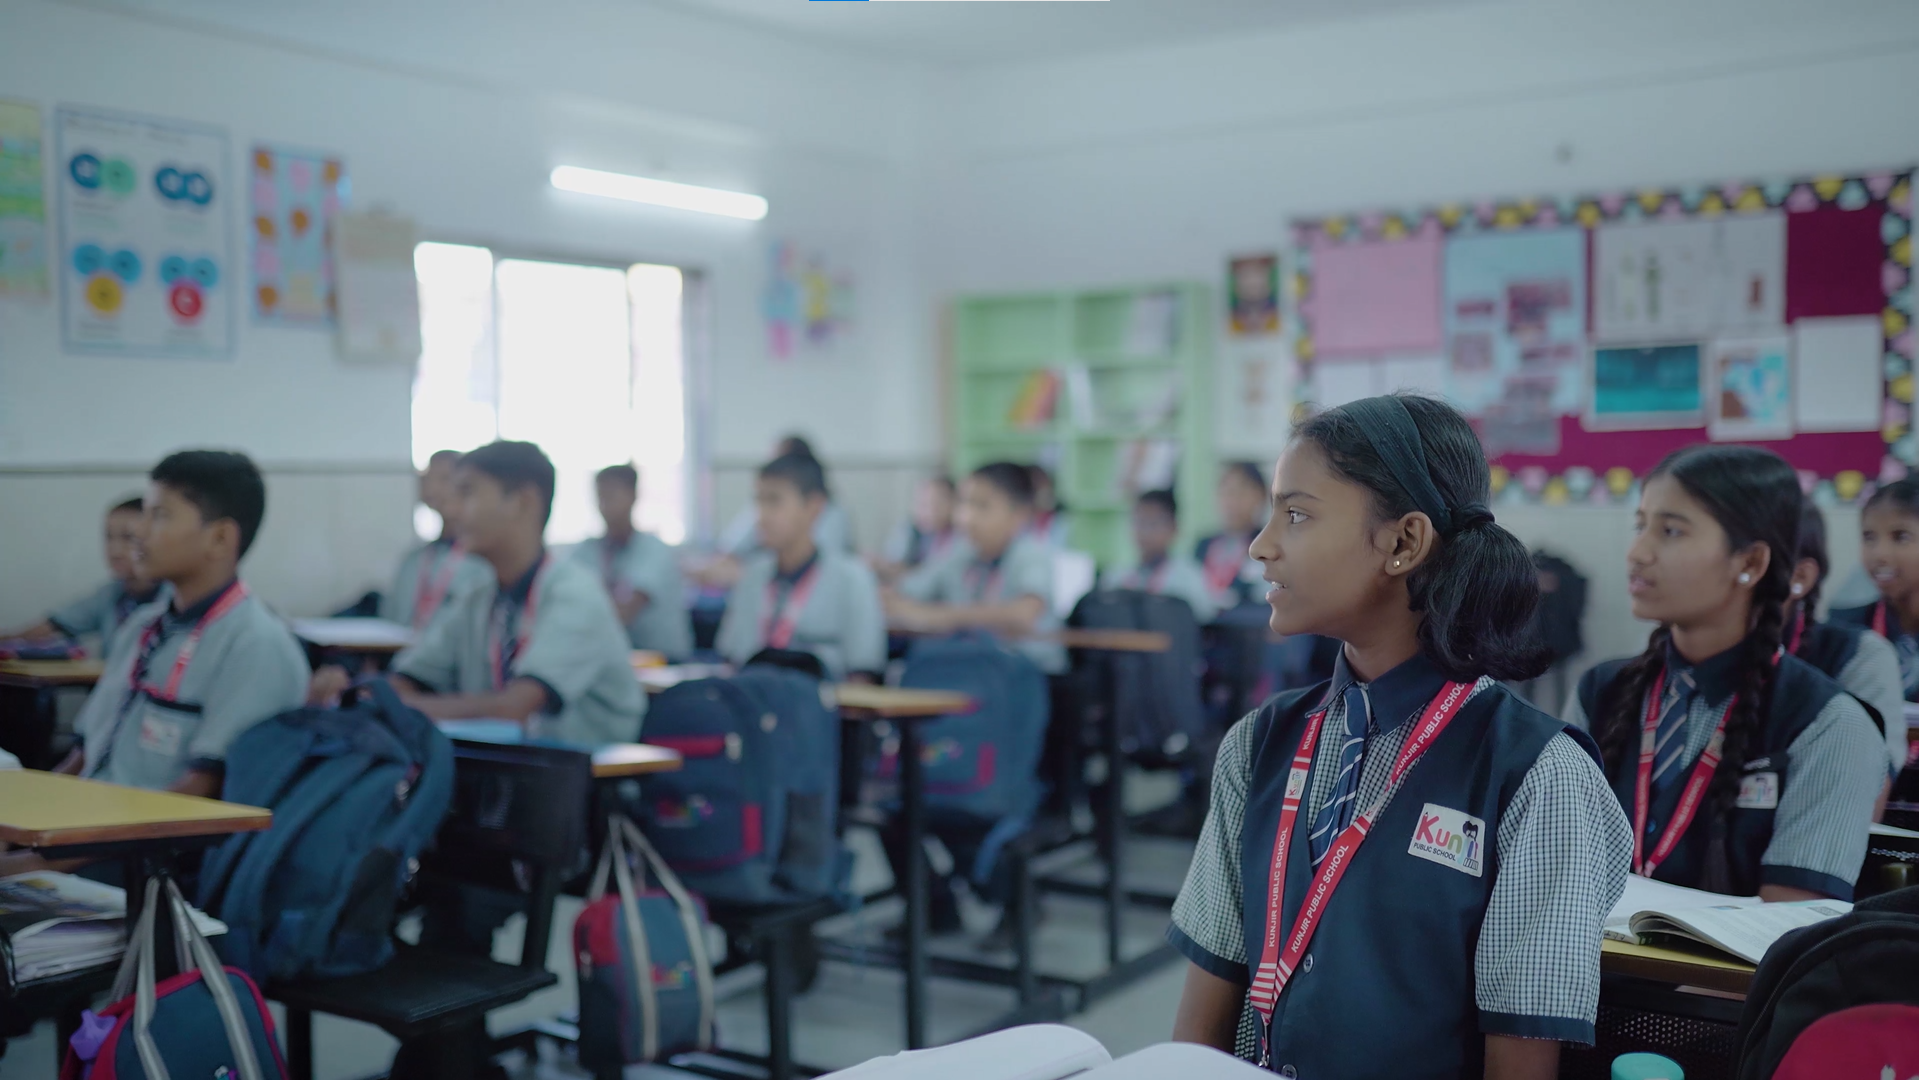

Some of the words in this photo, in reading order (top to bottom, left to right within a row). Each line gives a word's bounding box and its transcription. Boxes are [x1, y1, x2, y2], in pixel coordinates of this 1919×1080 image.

[1302, 718, 1319, 750] KUNJIR
[1396, 743, 1420, 775] KUNJIR
[1417, 711, 1444, 744] PUBLIC
[1440, 682, 1467, 713] SCHOO
[1276, 827, 1288, 868] SCHOOL
[1414, 842, 1432, 853] PUBLIC
[1433, 848, 1456, 861] SCHOOL
[1272, 871, 1280, 908] PUBLIC
[1291, 918, 1311, 953] KUNJIR
[1306, 883, 1327, 919] PUBLIC
[1323, 844, 1349, 884] SCHOOL
[1269, 910, 1277, 947] KUNJIR
